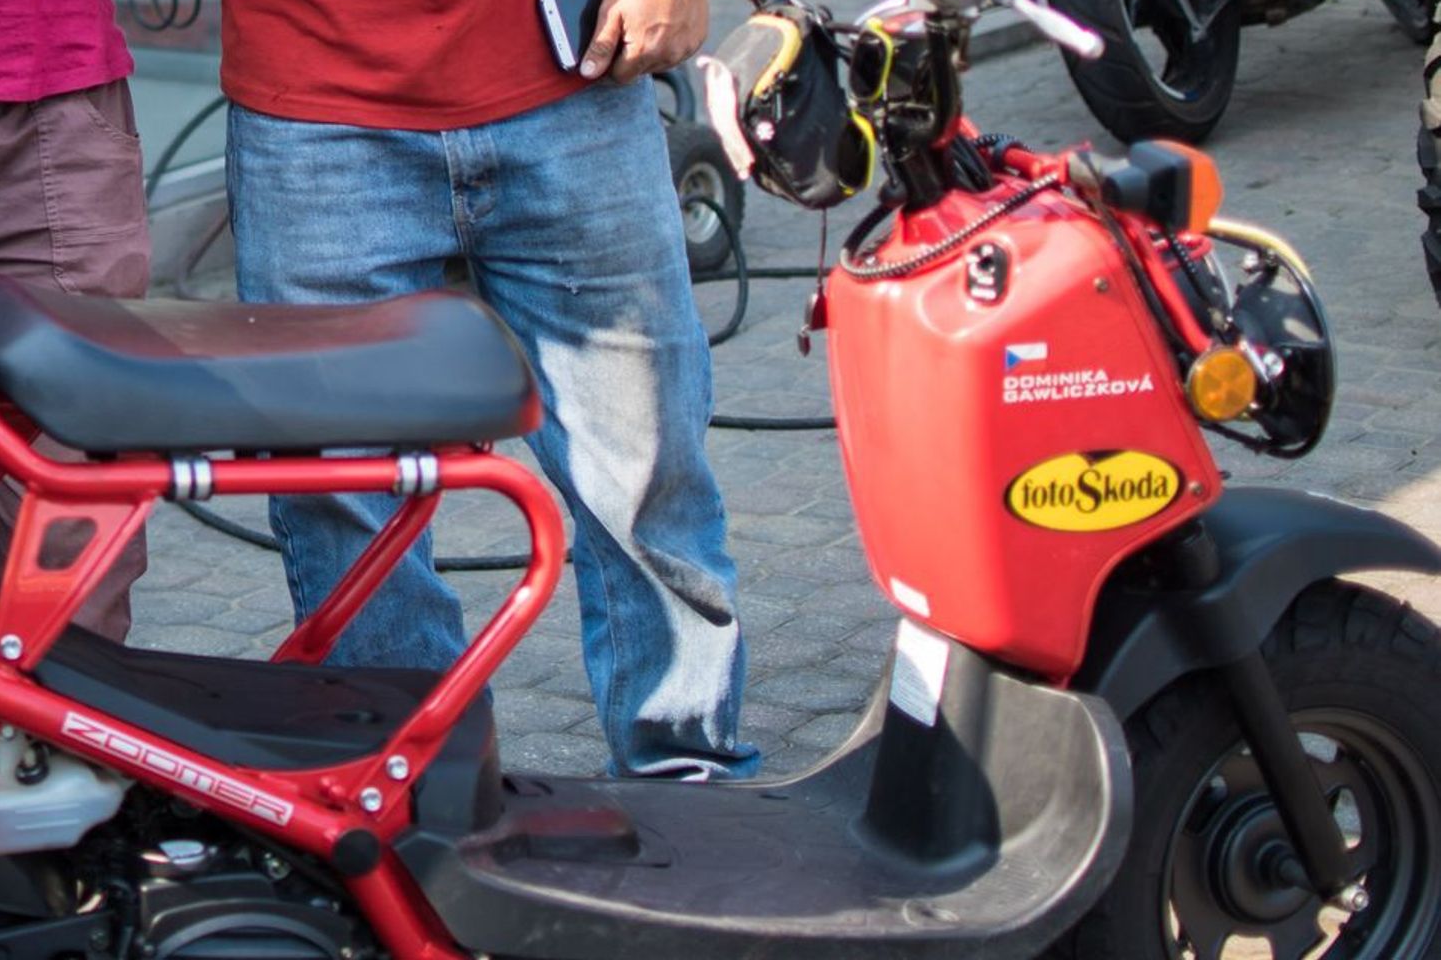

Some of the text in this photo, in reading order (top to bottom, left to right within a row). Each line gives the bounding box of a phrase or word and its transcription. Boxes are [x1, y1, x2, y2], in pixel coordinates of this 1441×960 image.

[1003, 368, 1108, 391] DOMINIKA
[1003, 372, 1154, 404] GAWLICZKOVÁ
[61, 710, 294, 827] ZOOMER
